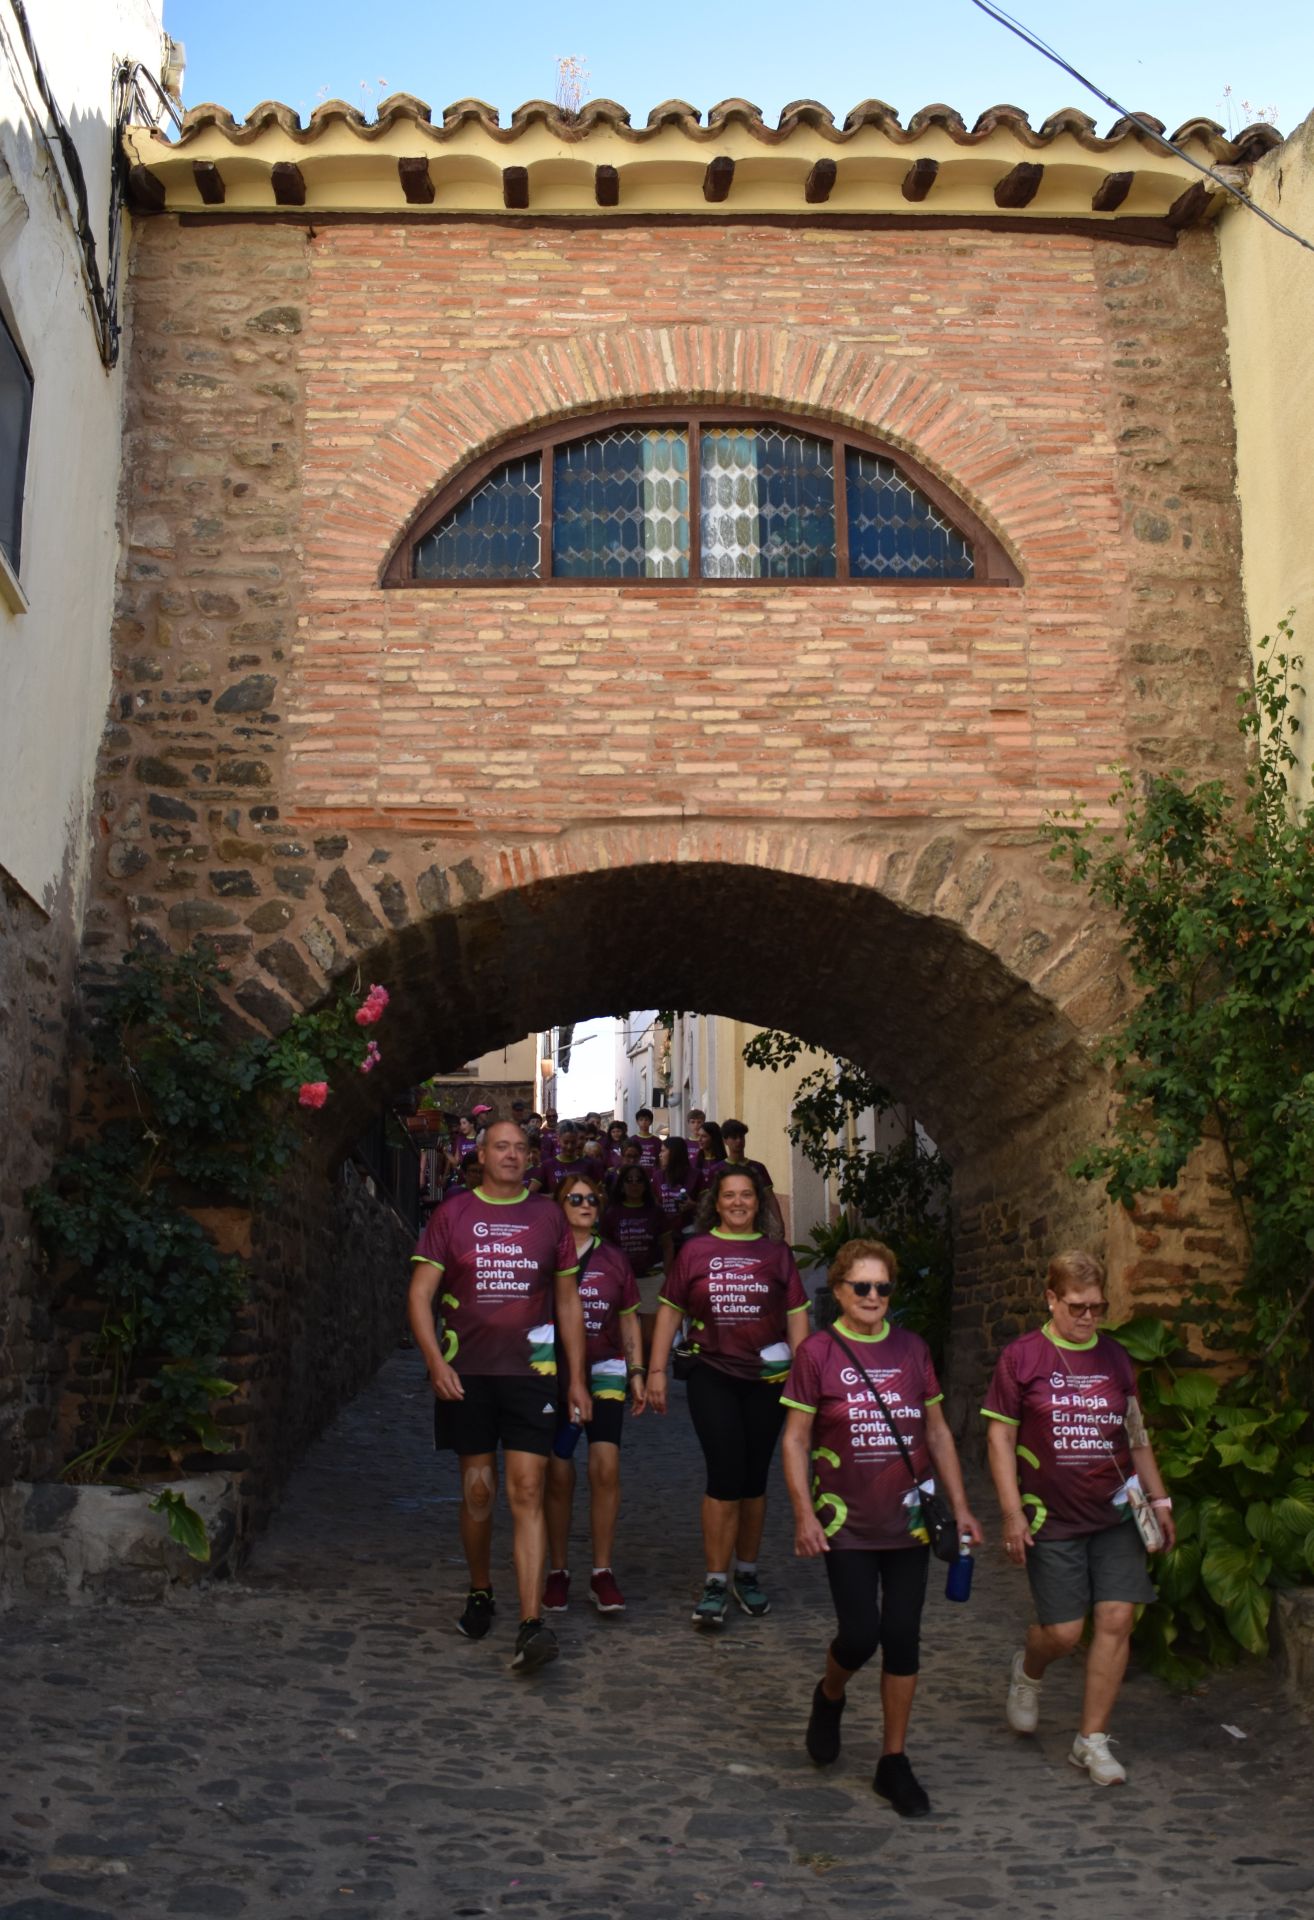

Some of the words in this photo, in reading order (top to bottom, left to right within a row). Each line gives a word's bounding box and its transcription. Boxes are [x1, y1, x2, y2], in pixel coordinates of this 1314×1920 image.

[476, 1243, 491, 1253] La
[493, 1243, 522, 1255] Rioja
[476, 1257, 491, 1268] En
[493, 1258, 538, 1270] marcha
[476, 1269, 514, 1279] contra
[709, 1272, 723, 1280] La
[725, 1272, 754, 1281] Rioja
[476, 1280, 487, 1290] el
[489, 1280, 530, 1291] cáncer
[708, 1282, 723, 1292] En
[725, 1282, 769, 1293] marcha
[578, 1286, 598, 1297] ioja
[709, 1293, 746, 1303] contra
[711, 1302, 721, 1313] el
[722, 1303, 761, 1313] cáncer
[847, 1392, 865, 1403] La
[866, 1390, 901, 1405] Roja
[1051, 1394, 1070, 1405] La
[1072, 1395, 1108, 1409] Rioja
[848, 1407, 867, 1420] En
[870, 1406, 921, 1419] mrcha
[1052, 1410, 1070, 1422] En
[1073, 1412, 1123, 1425] marcha
[1053, 1425, 1099, 1436] contra
[851, 1434, 866, 1447] el
[1053, 1437, 1068, 1449] el
